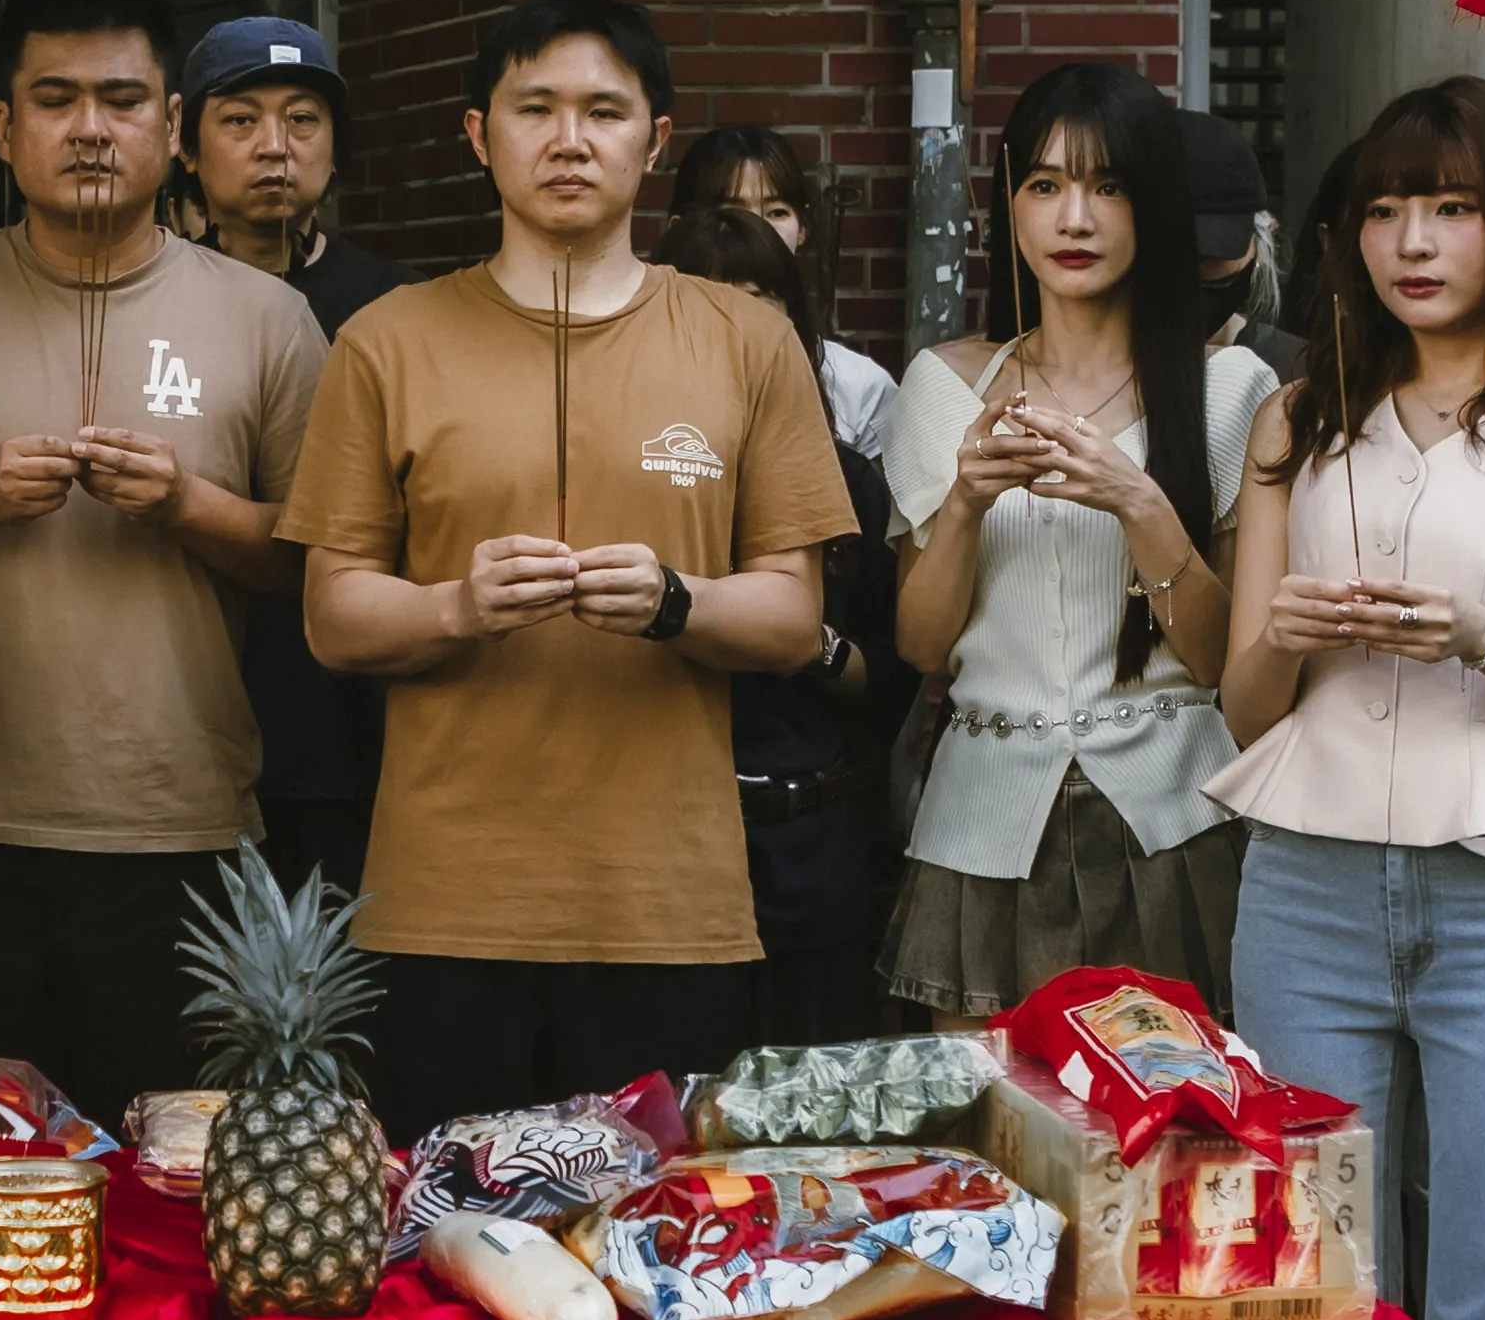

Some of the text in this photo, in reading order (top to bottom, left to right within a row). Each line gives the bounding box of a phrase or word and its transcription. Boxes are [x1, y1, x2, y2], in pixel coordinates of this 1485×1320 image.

[143, 339, 201, 415] LA
[670, 473, 697, 487] 1969
[1338, 1153, 1357, 1184] 5
[1334, 1204, 1354, 1236] 6
